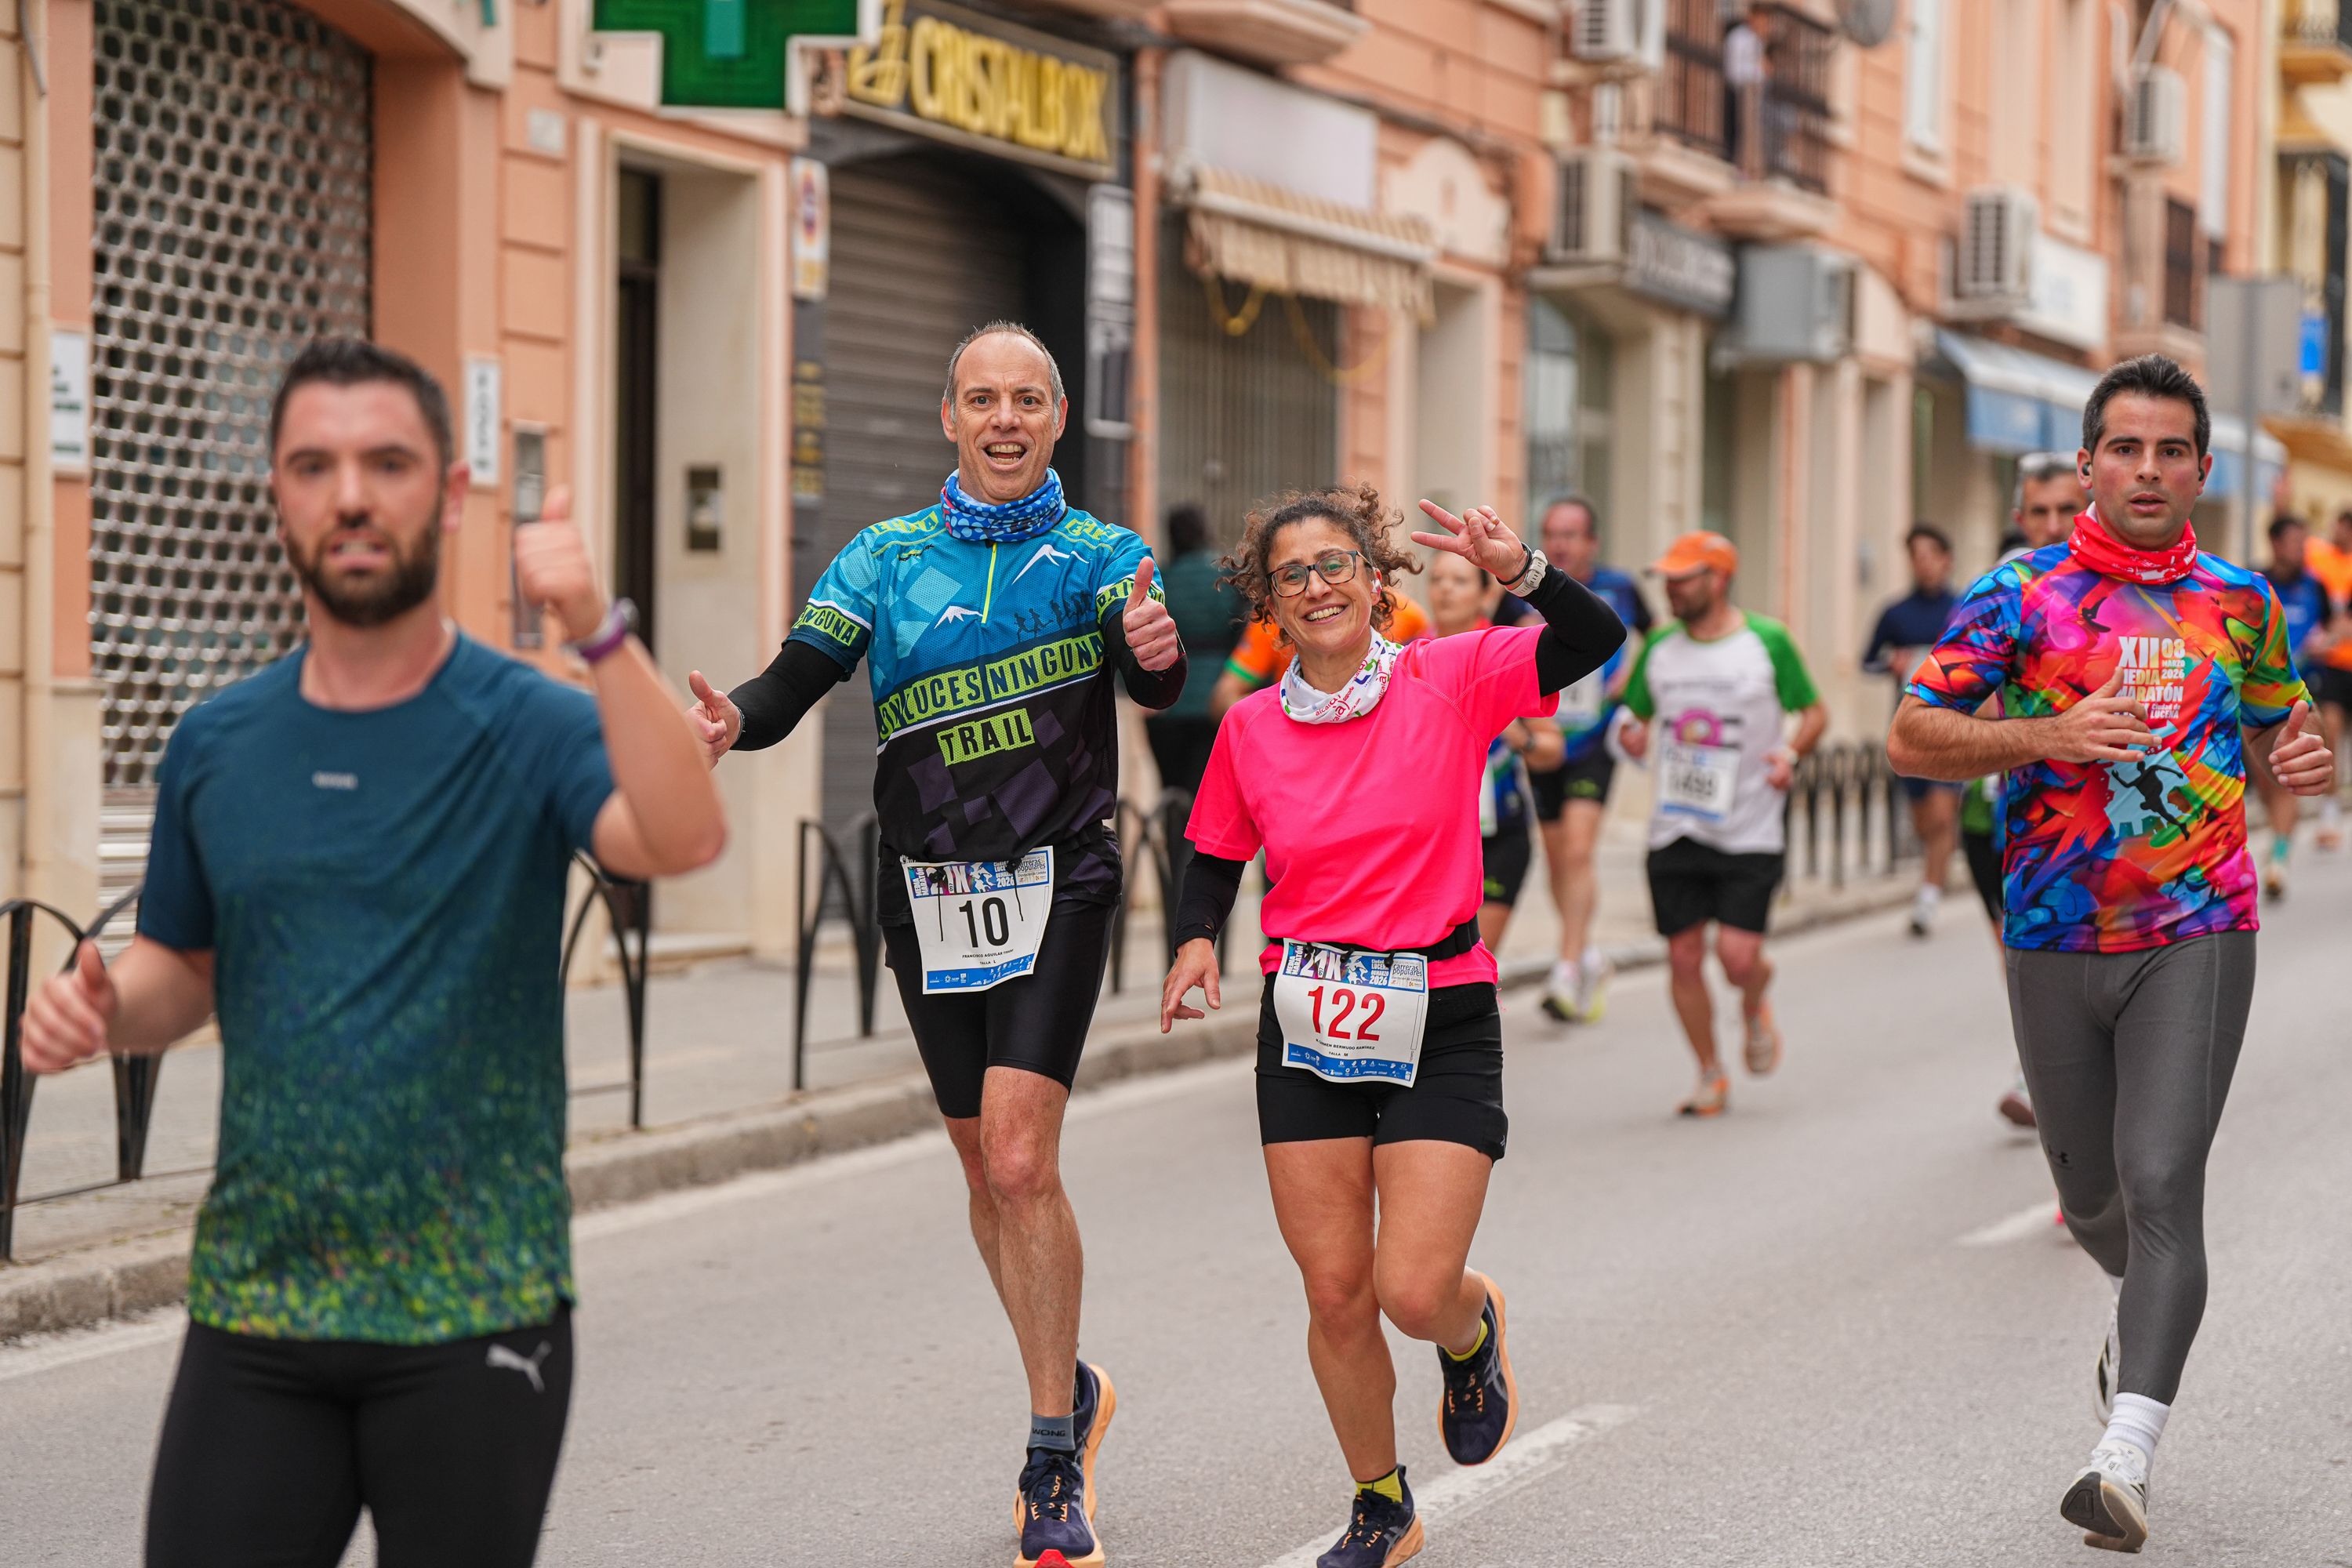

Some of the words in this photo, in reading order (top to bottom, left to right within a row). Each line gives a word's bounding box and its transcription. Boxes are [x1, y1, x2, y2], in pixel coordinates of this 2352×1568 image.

[2118, 637, 2159, 668] XII
[2161, 638, 2186, 659] 08
[904, 672, 981, 720] LUCES
[990, 634, 1105, 695] NINGUNA
[2123, 669, 2161, 686] EDIA
[2161, 669, 2185, 680] 2026
[2150, 710, 2180, 719] LUCENA
[940, 714, 1031, 761] TRAIL
[996, 877, 1014, 888] 2026
[959, 897, 1010, 948] 10
[1368, 975, 1388, 986] 2026
[1392, 968, 1423, 977] populares
[1307, 985, 1385, 1042] 122
[1032, 1428, 1066, 1438] WONG
